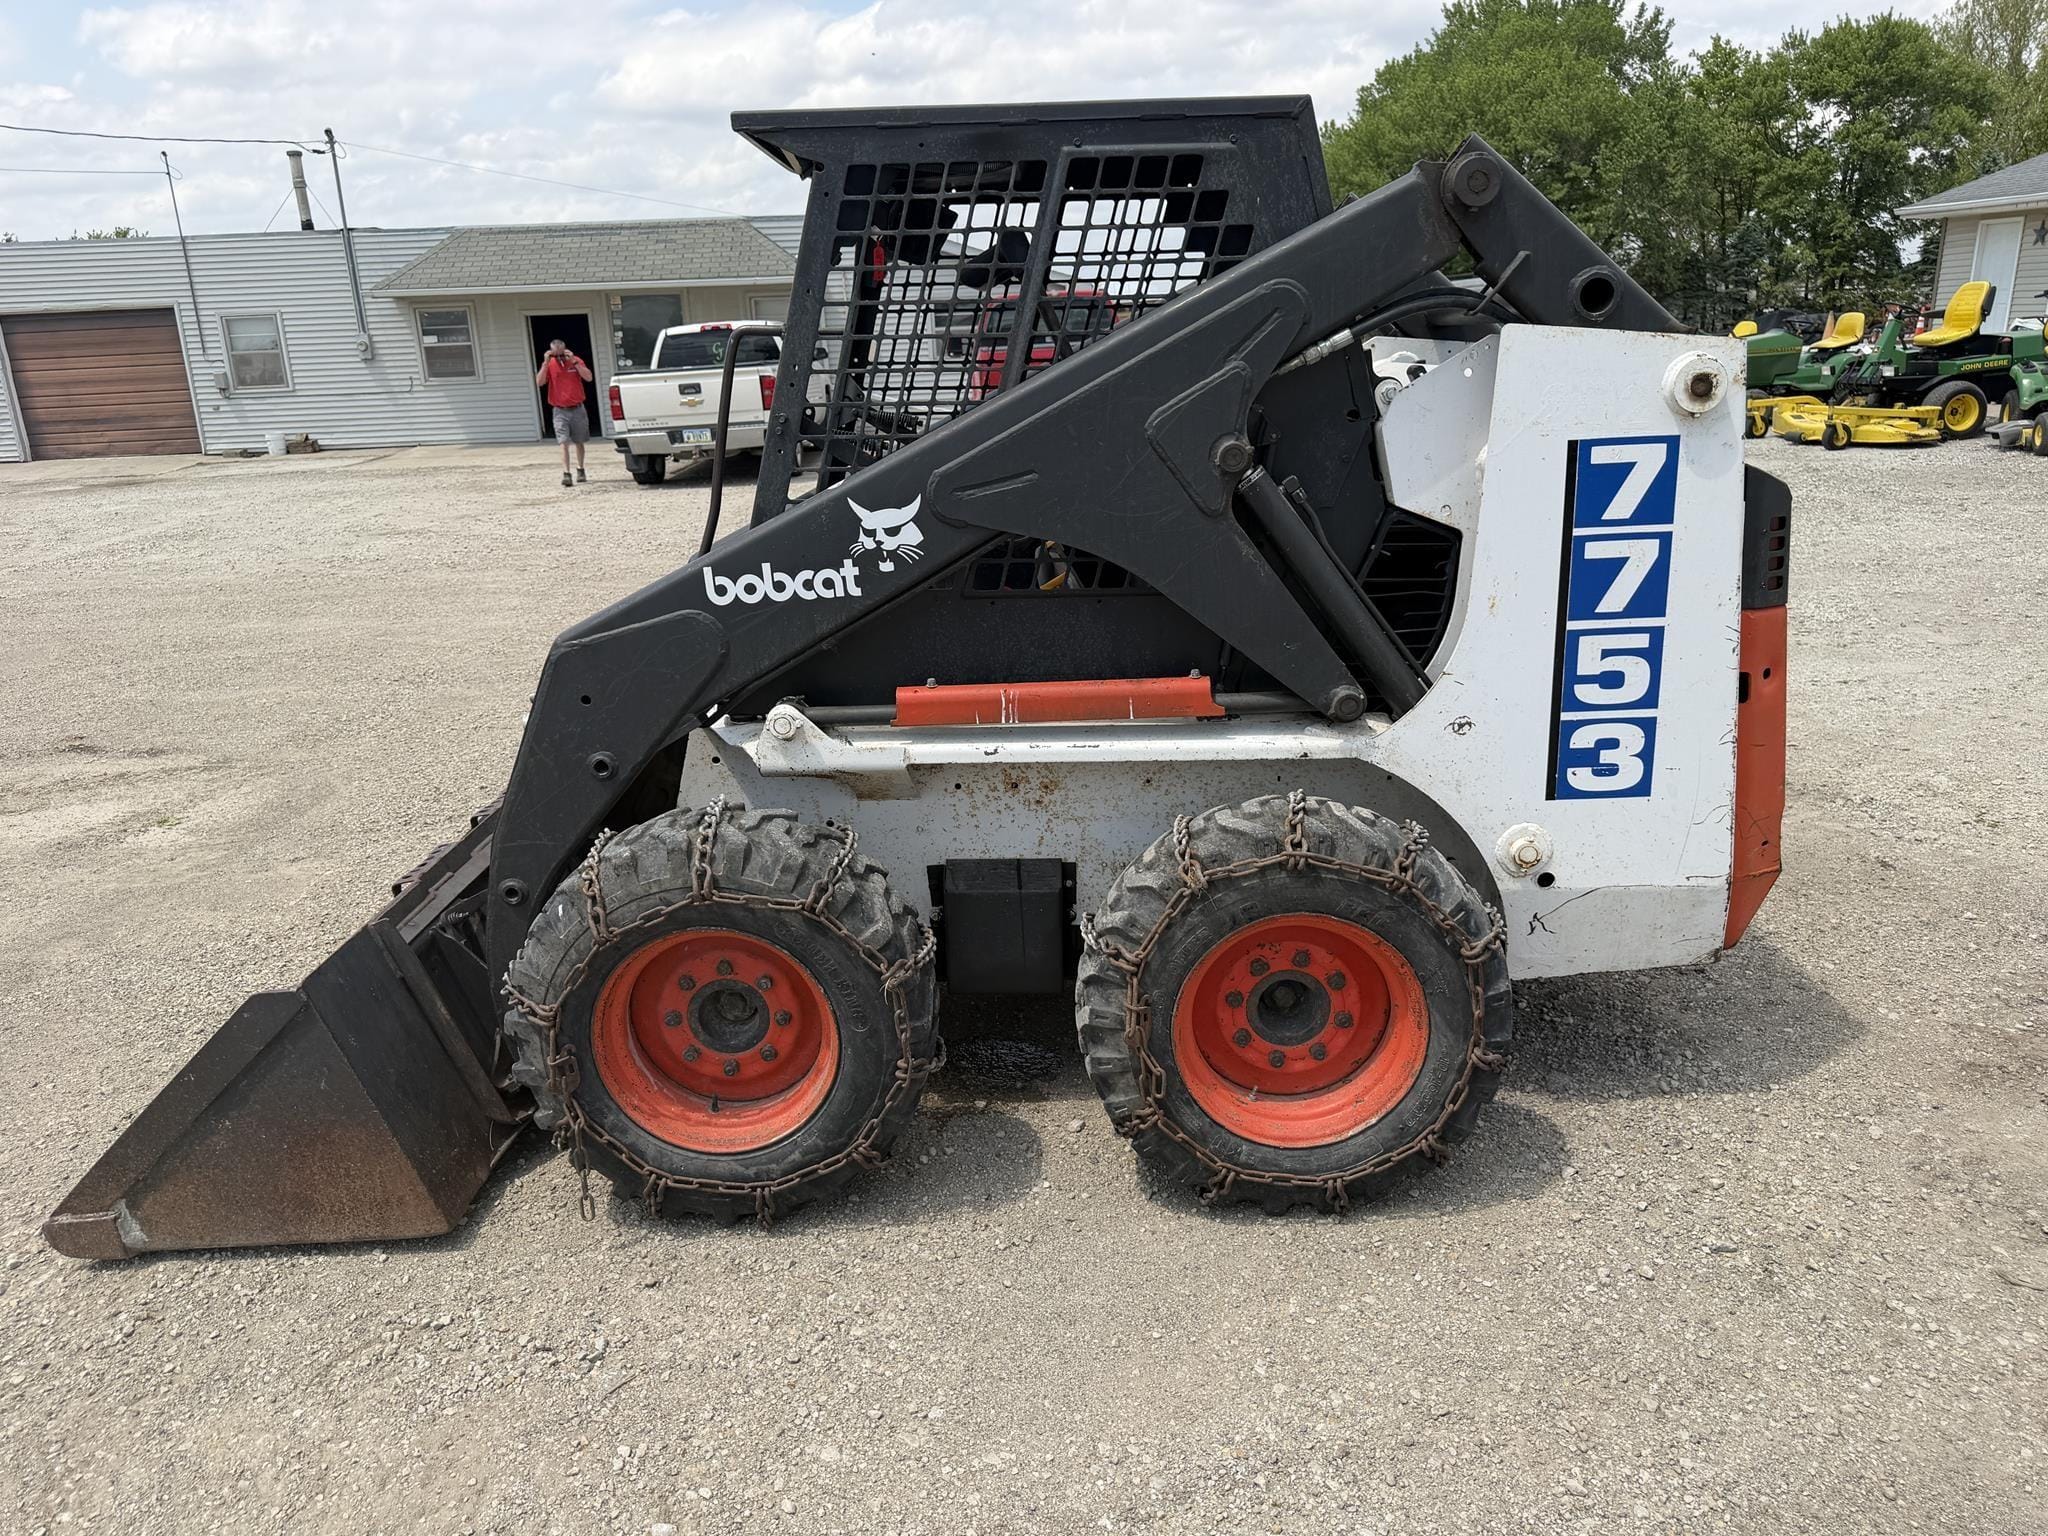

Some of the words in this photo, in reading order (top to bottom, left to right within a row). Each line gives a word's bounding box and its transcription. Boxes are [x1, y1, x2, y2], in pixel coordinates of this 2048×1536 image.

[1961, 362, 1982, 370] JOHN
[1984, 359, 2008, 368] DEERE
[703, 558, 862, 606] bobcat
[1567, 443, 1667, 792] 7753
